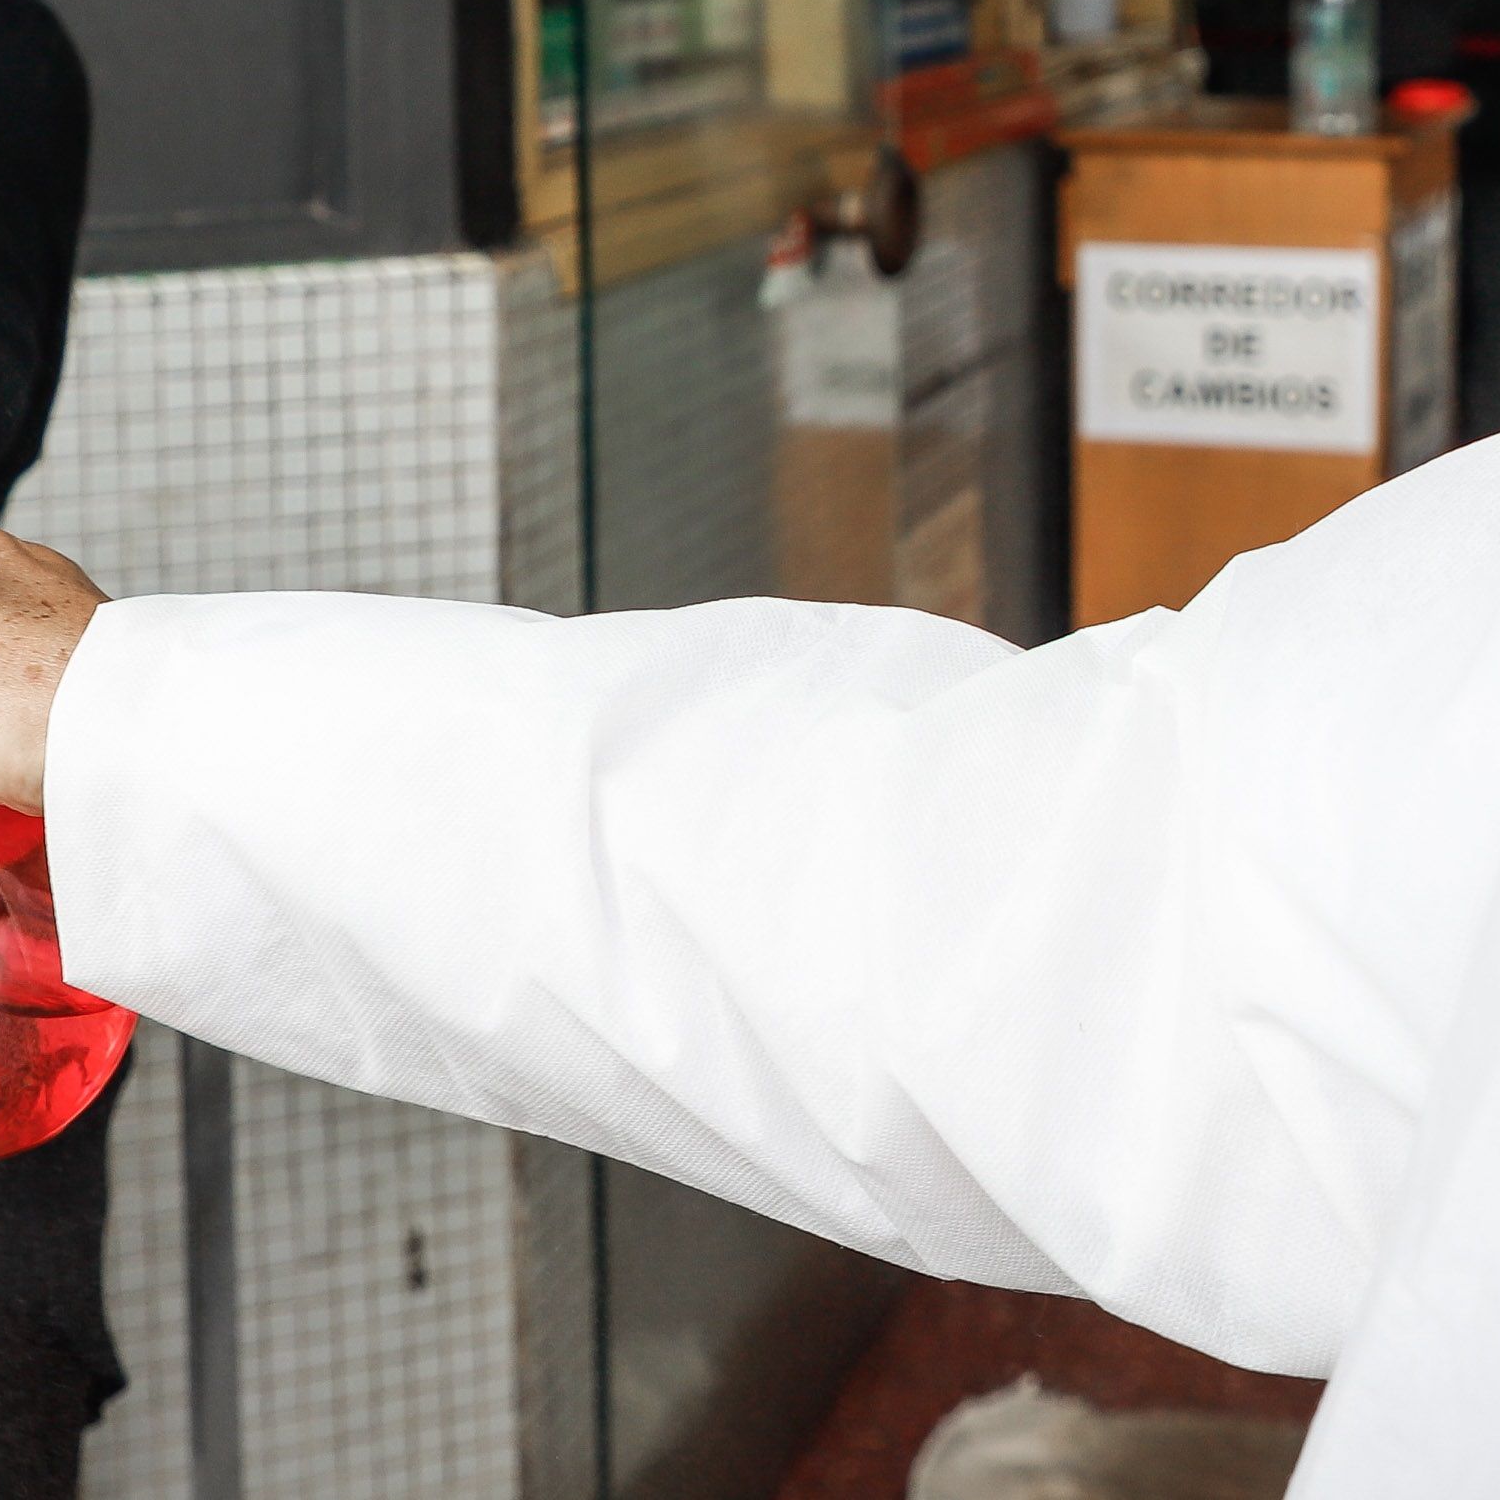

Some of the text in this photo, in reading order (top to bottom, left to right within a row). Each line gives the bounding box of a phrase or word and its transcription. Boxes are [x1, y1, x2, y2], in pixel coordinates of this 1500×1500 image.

[1108, 272, 1362, 318] CORREDOR
[1204, 324, 1262, 364] DE
[1130, 370, 1341, 414] CAMBIOS
